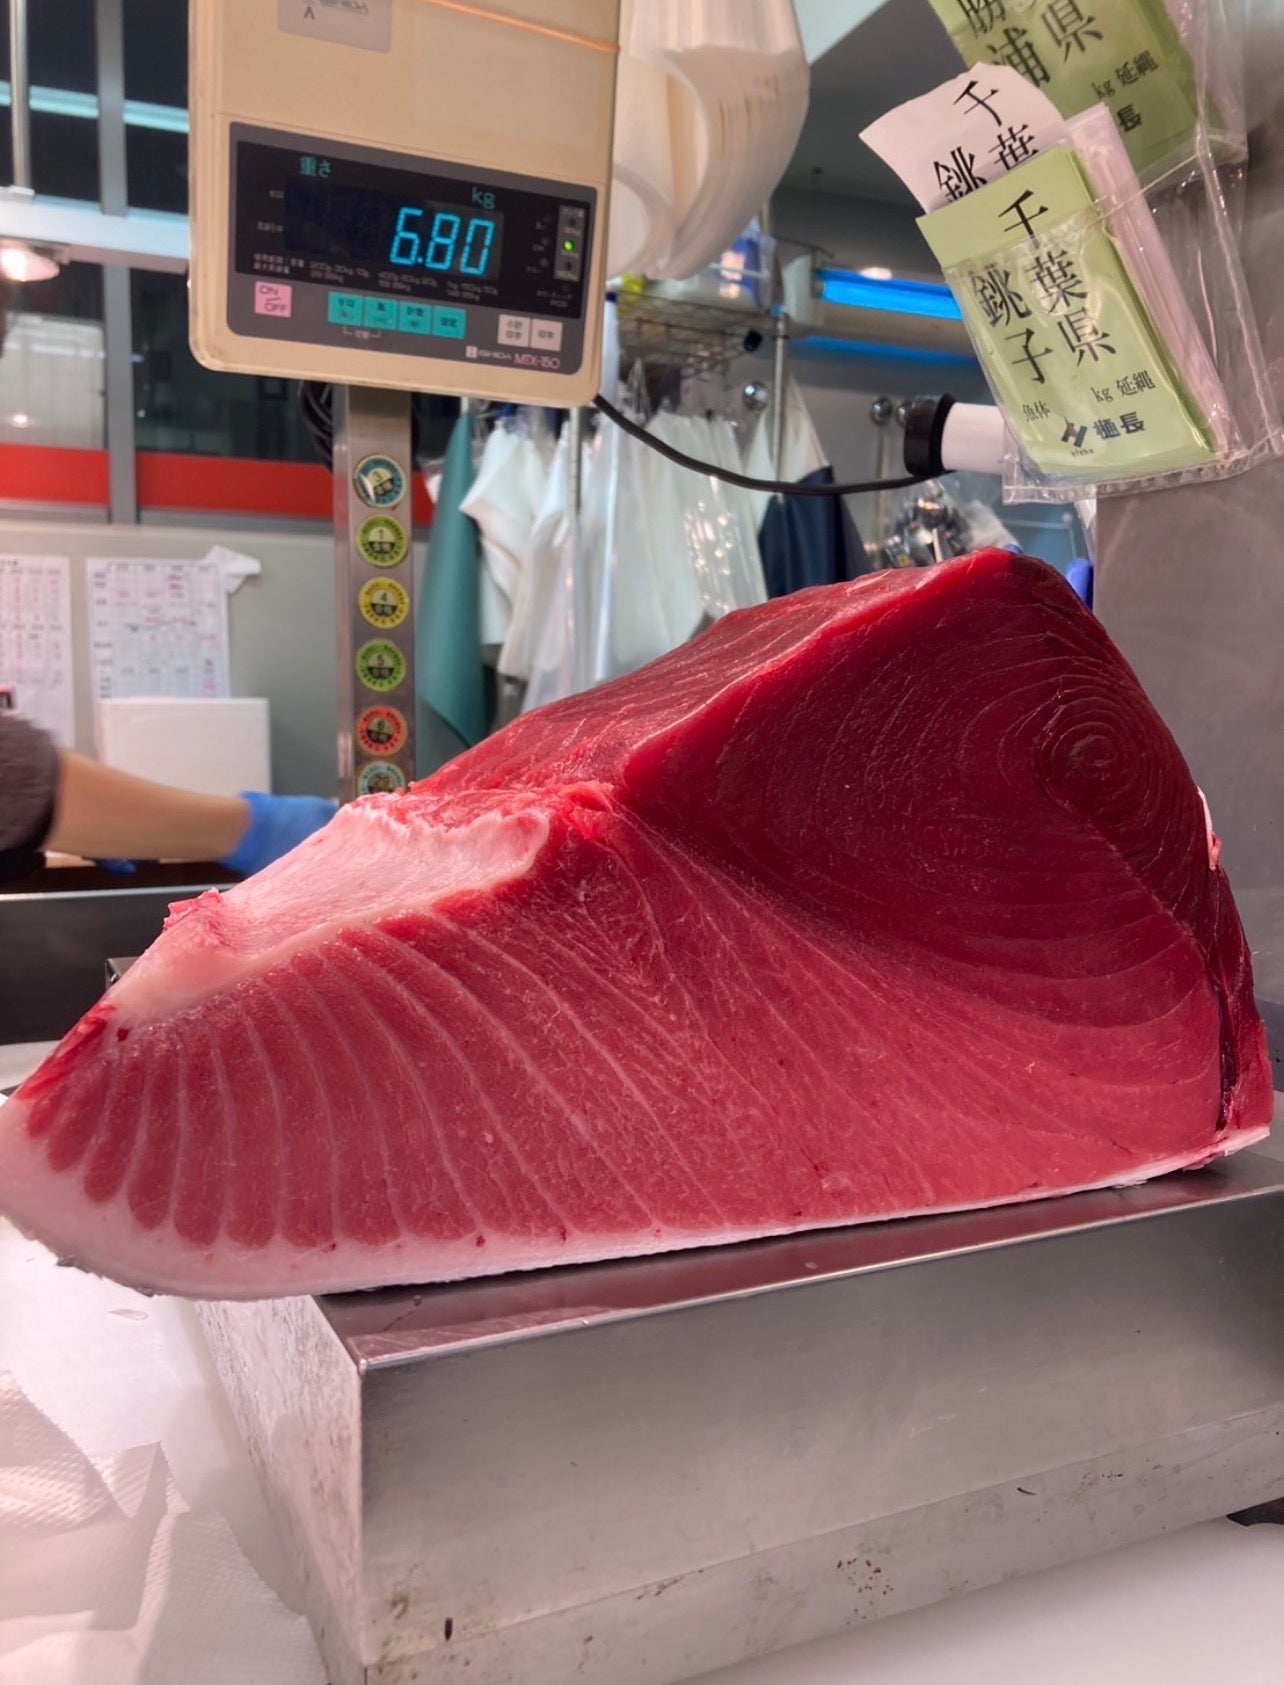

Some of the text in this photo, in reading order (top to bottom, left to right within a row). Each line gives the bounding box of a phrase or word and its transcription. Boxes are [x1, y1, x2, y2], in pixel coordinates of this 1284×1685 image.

[300, 156, 332, 178] 重さ
[471, 187, 496, 209] kg
[389, 206, 495, 275] 6.80
[998, 190, 1116, 367] 千葉県
[259, 285, 279, 296] ON
[264, 303, 288, 313] OFF
[968, 263, 1053, 385] 銚子
[1090, 386, 1114, 403] kg
